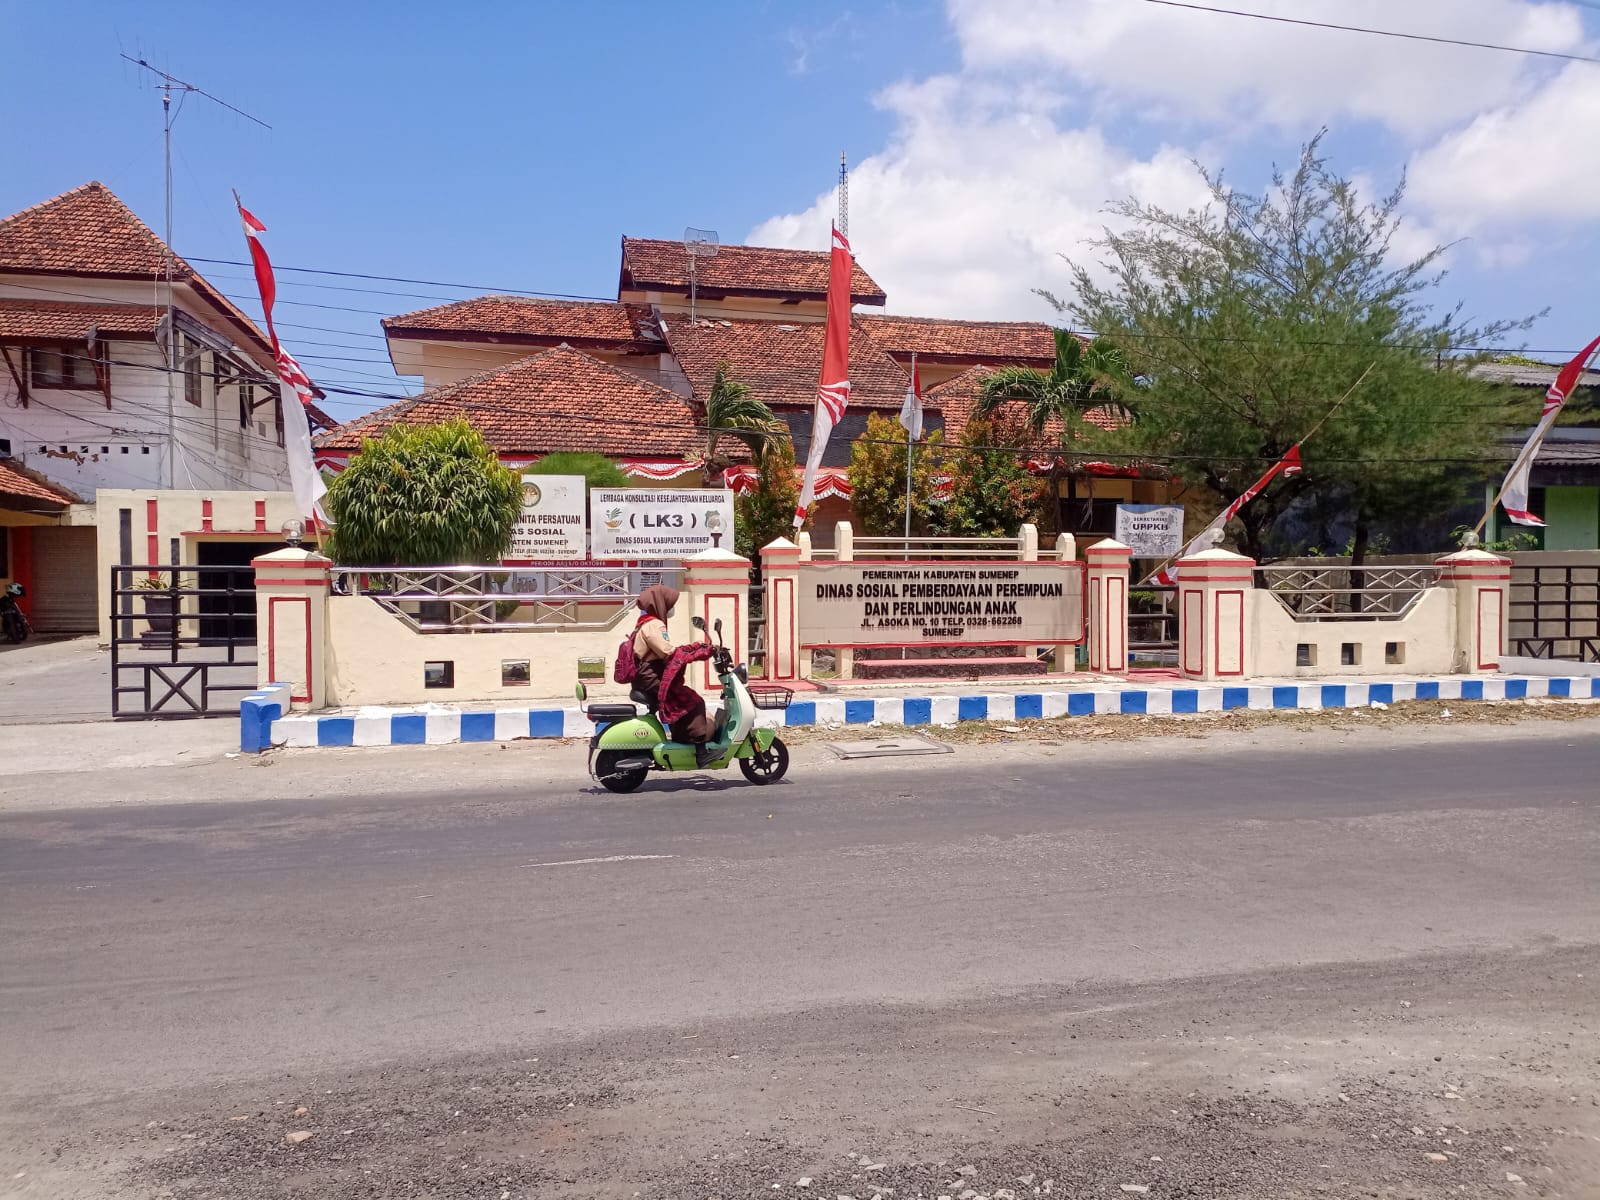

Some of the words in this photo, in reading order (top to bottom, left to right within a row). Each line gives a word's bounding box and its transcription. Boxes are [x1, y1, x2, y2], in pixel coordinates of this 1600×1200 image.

[600, 494, 624, 503] LEMBAGA
[625, 494, 656, 503] KONSULTASI
[657, 494, 698, 503] KESEJAHTERAAN
[699, 495, 725, 503] KELUARGA
[514, 514, 537, 525] ANITA
[538, 514, 581, 525] PERSATUAN
[527, 528, 566, 536] SOSIAL
[615, 536, 633, 544] DINAS
[633, 536, 652, 544] SOSIAL
[653, 536, 684, 544] KABUPATEN
[685, 536, 710, 544] SUMENEP
[862, 570, 921, 580] PEMERINTAH
[923, 570, 976, 580] KABUPATEN
[978, 570, 1019, 580] SUMENEP
[816, 583, 853, 598] DINAS
[856, 583, 899, 598] SOSIAL
[902, 583, 993, 598] PEMBERDAYAAN
[996, 583, 1063, 597] PEREMPUAN
[864, 601, 889, 616] DAN
[892, 601, 982, 616] PERLINDUNGAN
[984, 601, 1017, 615] ANAK
[860, 618, 874, 627] JL.
[877, 617, 910, 627] ASOKA
[912, 617, 928, 627] NO.
[929, 617, 939, 626] 10
[941, 617, 965, 626] TELP.
[922, 628, 965, 637] SUMENEP
